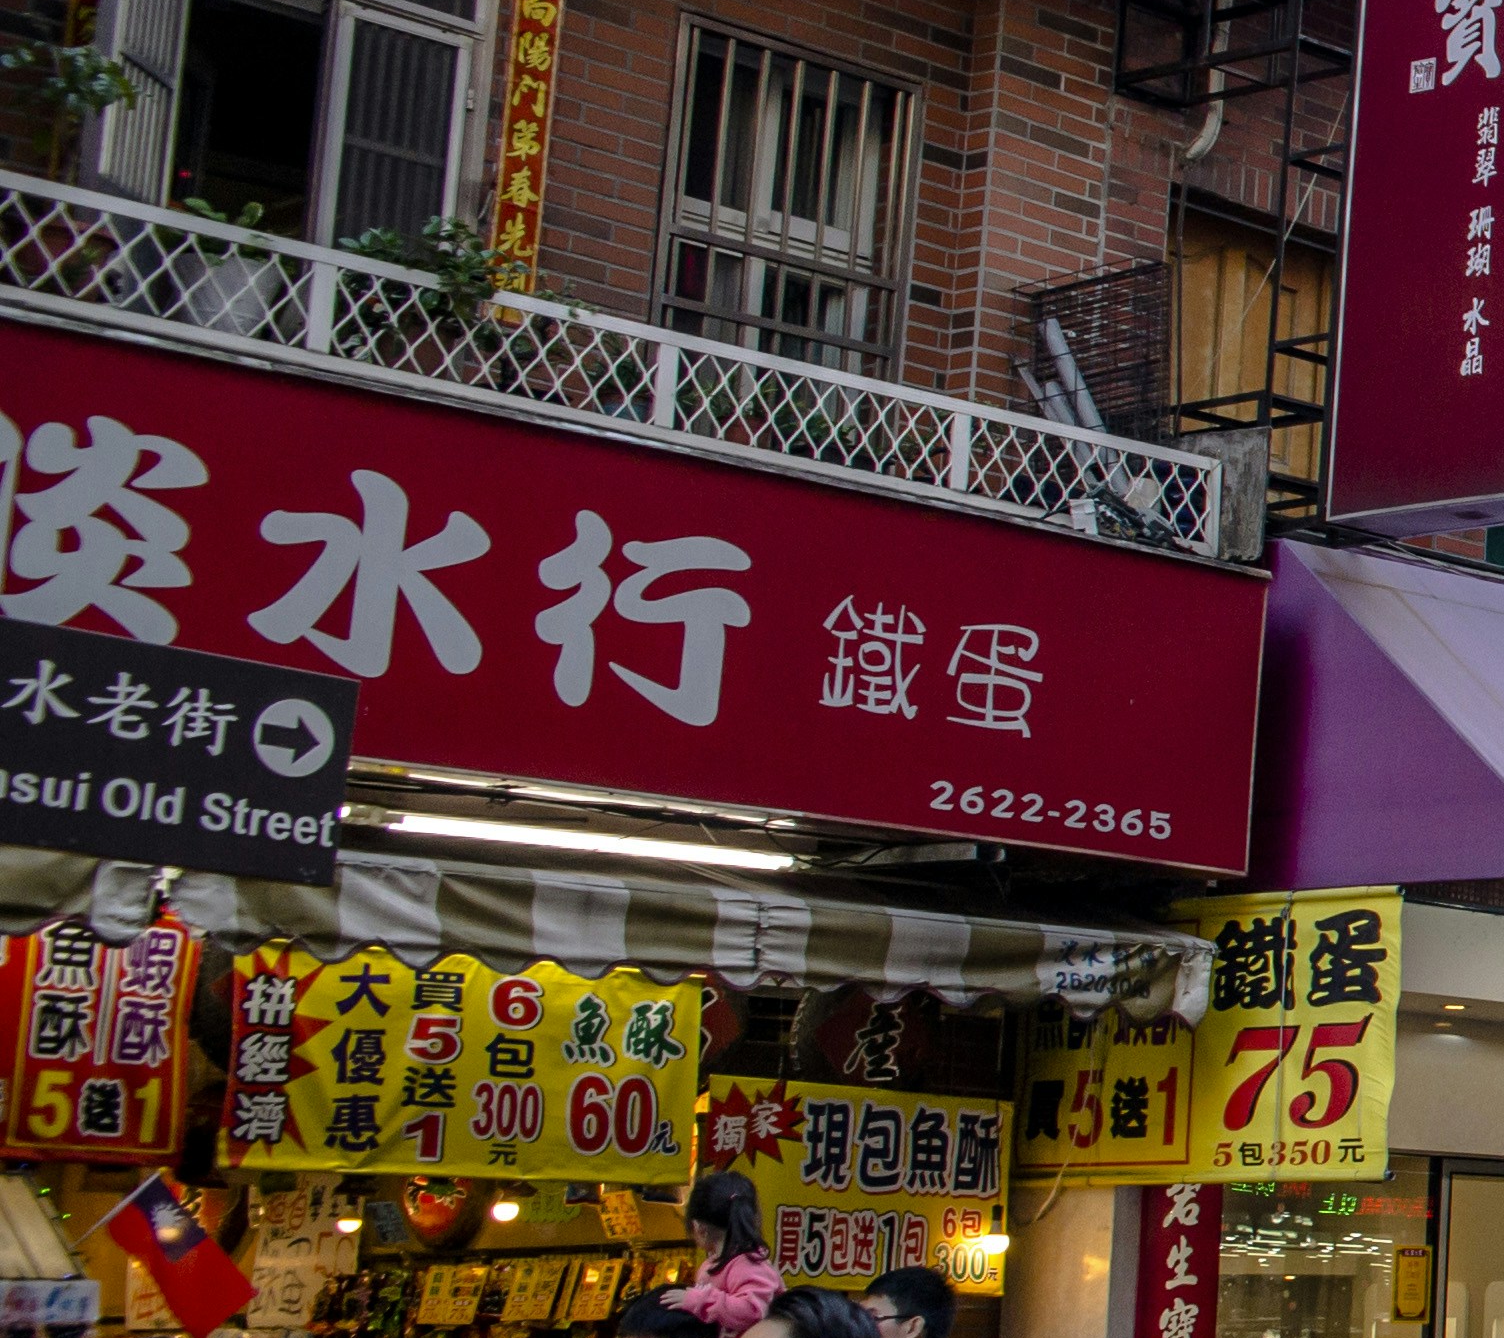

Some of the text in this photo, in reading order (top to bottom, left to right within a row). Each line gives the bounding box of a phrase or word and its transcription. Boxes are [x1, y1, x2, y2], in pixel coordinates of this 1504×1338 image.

[1459, 108, 1500, 378] 翡翠 珊瑚 水晶
[0, 415, 750, 726] 淡水行
[1, 659, 238, 756] 水老街
[820, 595, 1045, 737] 鐵蛋
[100, 777, 186, 825] Old
[200, 792, 336, 847] Street
[930, 780, 1173, 840] 2622-2365
[1213, 909, 1386, 1012] 鐵蛋
[233, 975, 298, 1143] 拼經濟
[322, 963, 393, 1152] 大優惠
[399, 969, 465, 1161] 買5送1
[563, 998, 686, 1065] 魚酥
[1223, 1013, 1375, 1131] 75
[28, 1069, 164, 1143] 5送1
[566, 1074, 681, 1156] 60元
[712, 1101, 784, 1154] 獨家
[1026, 1065, 1176, 1150] 買5送1
[802, 1101, 1001, 1197] 現包魚酥
[1213, 1137, 1365, 1168] 5包350元
[775, 1207, 928, 1280] 買5包送1包
[935, 1242, 998, 1283] 300元
[943, 1208, 982, 1238] 6包
